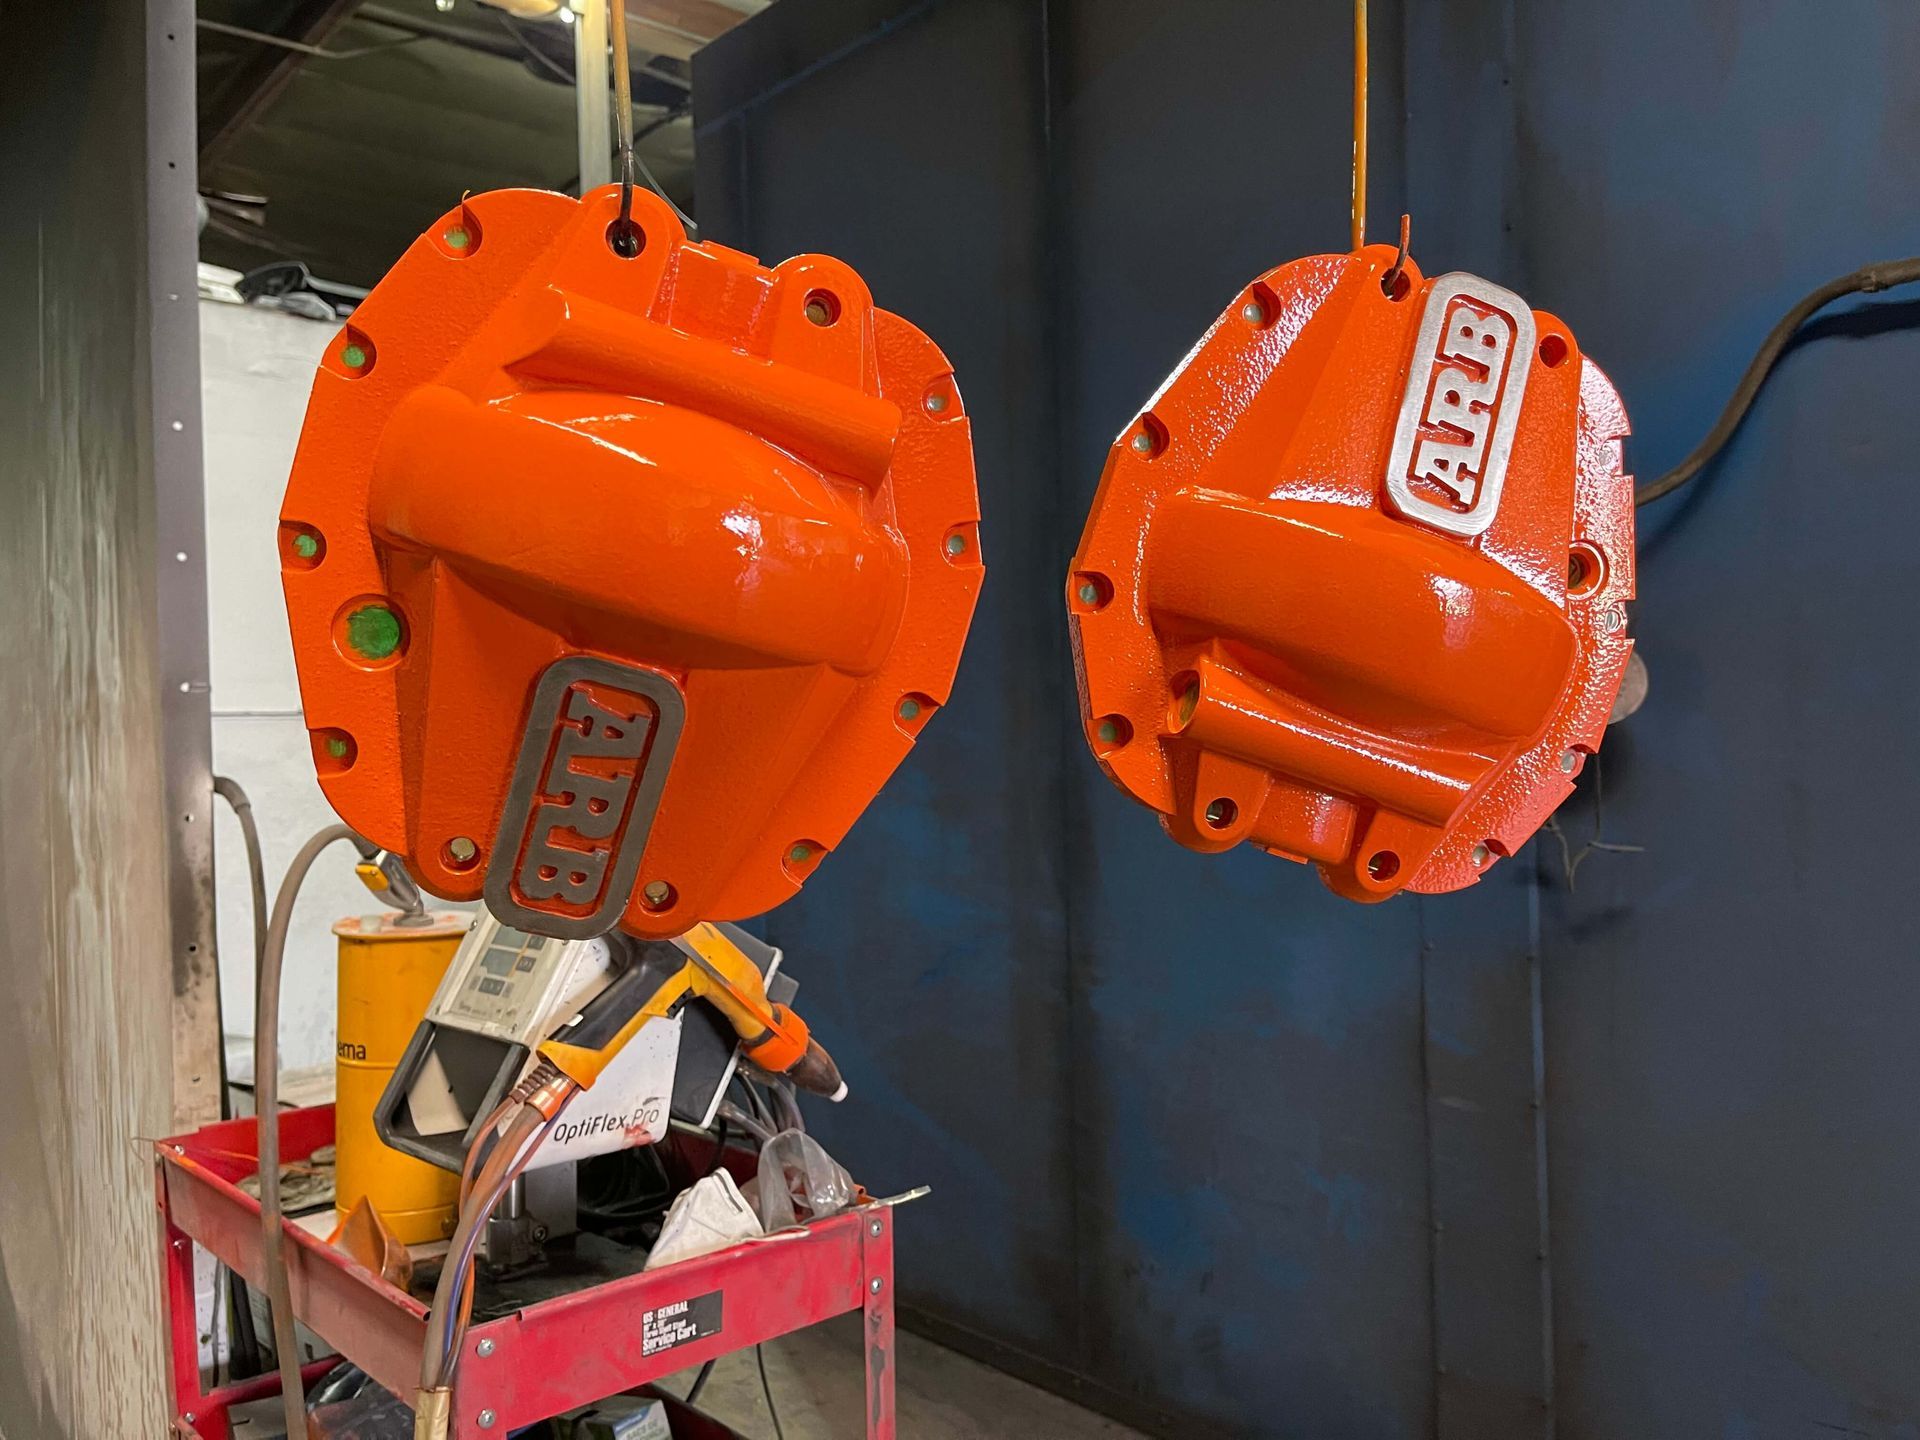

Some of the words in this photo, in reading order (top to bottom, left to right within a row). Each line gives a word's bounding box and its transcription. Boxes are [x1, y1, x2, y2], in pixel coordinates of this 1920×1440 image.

[1414, 306, 1511, 505] ARB
[519, 685, 652, 905] ARB
[553, 1113, 628, 1145] OptiFlex
[631, 1108, 660, 1127] Pro
